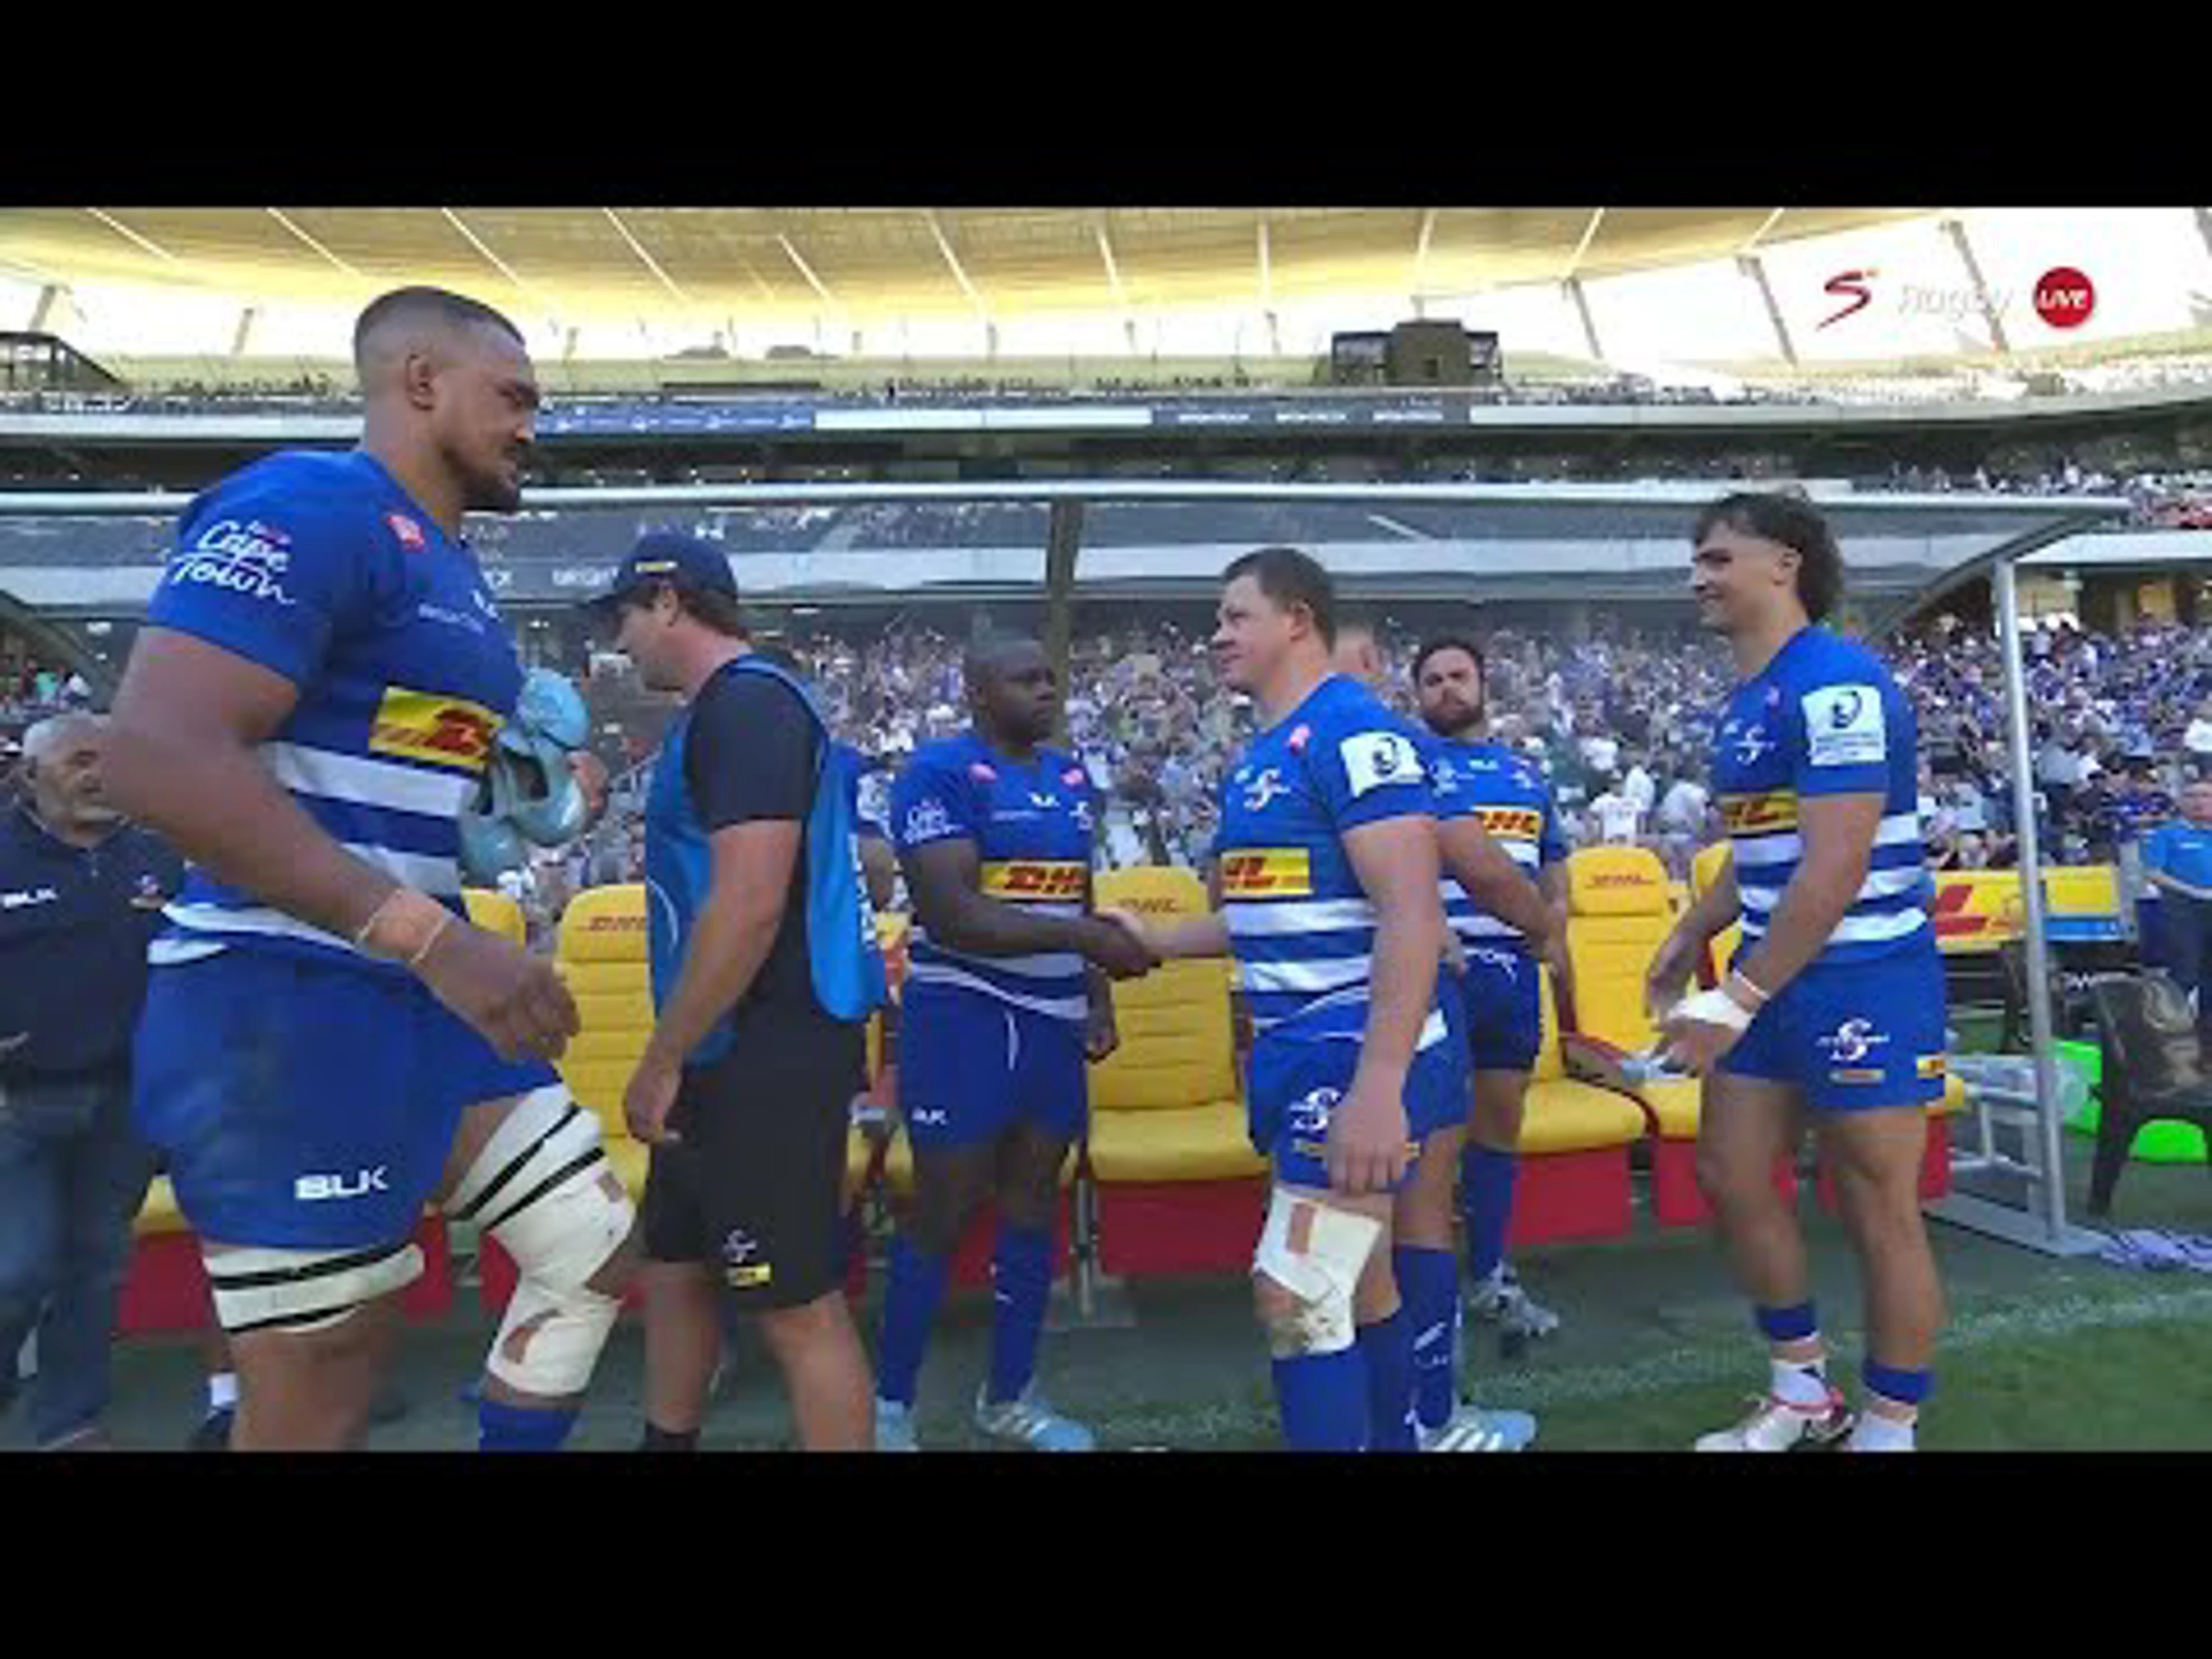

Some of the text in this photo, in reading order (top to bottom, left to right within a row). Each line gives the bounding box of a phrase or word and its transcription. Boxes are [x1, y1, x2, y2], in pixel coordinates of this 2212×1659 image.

[197, 520, 289, 571] Cape
[171, 552, 296, 603] Town
[295, 1165, 389, 1199] BLK
